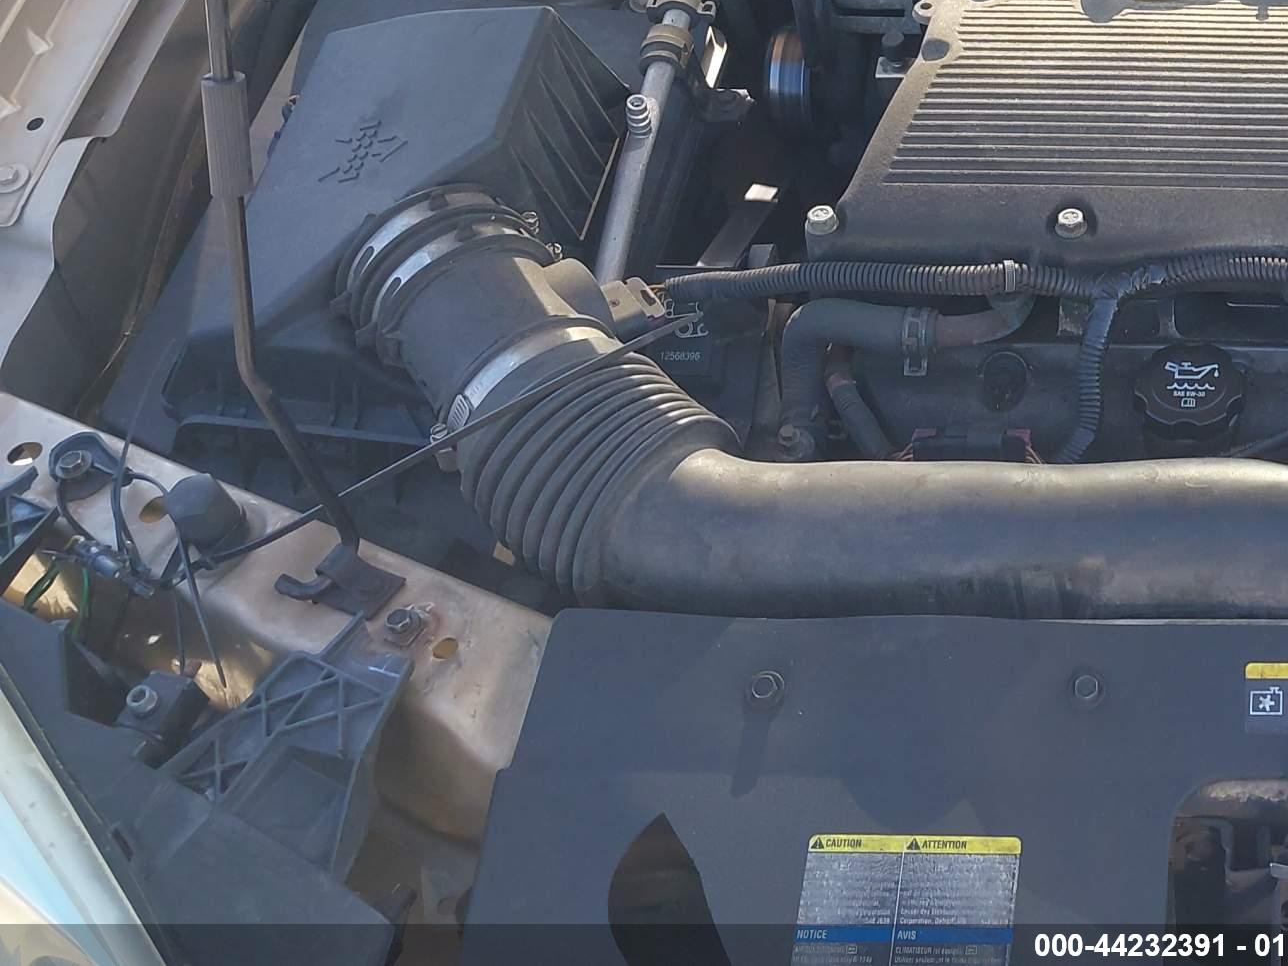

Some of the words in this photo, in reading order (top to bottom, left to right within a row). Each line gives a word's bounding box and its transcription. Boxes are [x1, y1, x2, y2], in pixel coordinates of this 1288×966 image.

[826, 838, 863, 849] CAUTION
[922, 839, 968, 850] ATTENTION
[796, 929, 828, 939] NOTICE
[897, 930, 917, 940] AVIS
